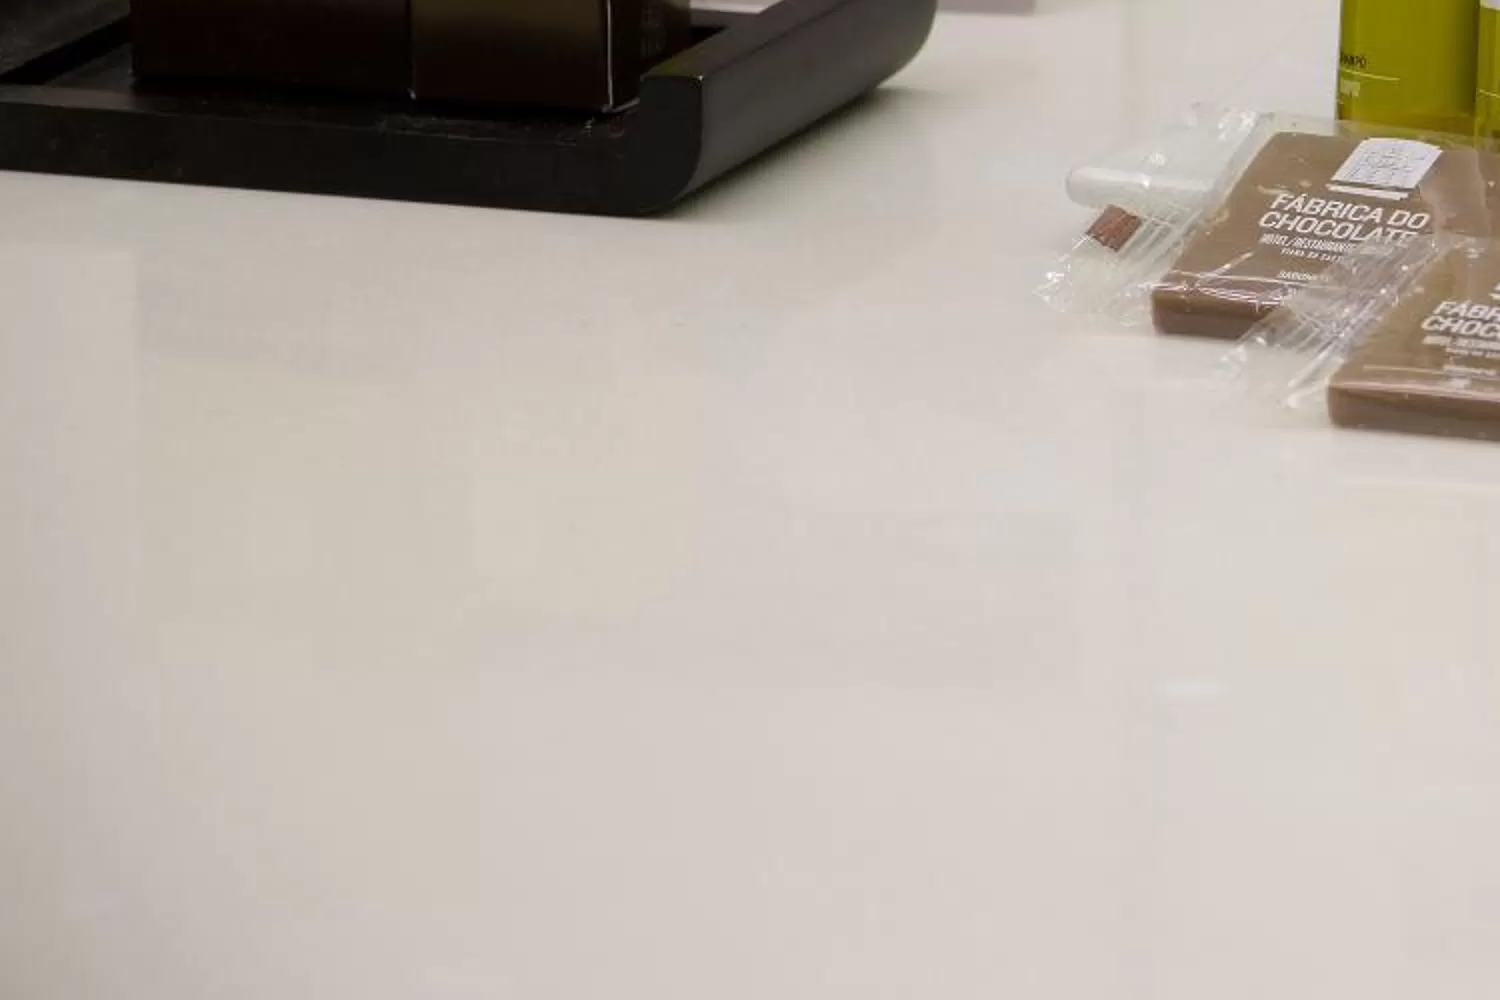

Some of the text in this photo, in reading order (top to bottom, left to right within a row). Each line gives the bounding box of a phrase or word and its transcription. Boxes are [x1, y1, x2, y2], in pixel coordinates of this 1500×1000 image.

[1258, 211, 1420, 248] CHOCOLATE
[1270, 192, 1431, 230] FÁBRICA DO
